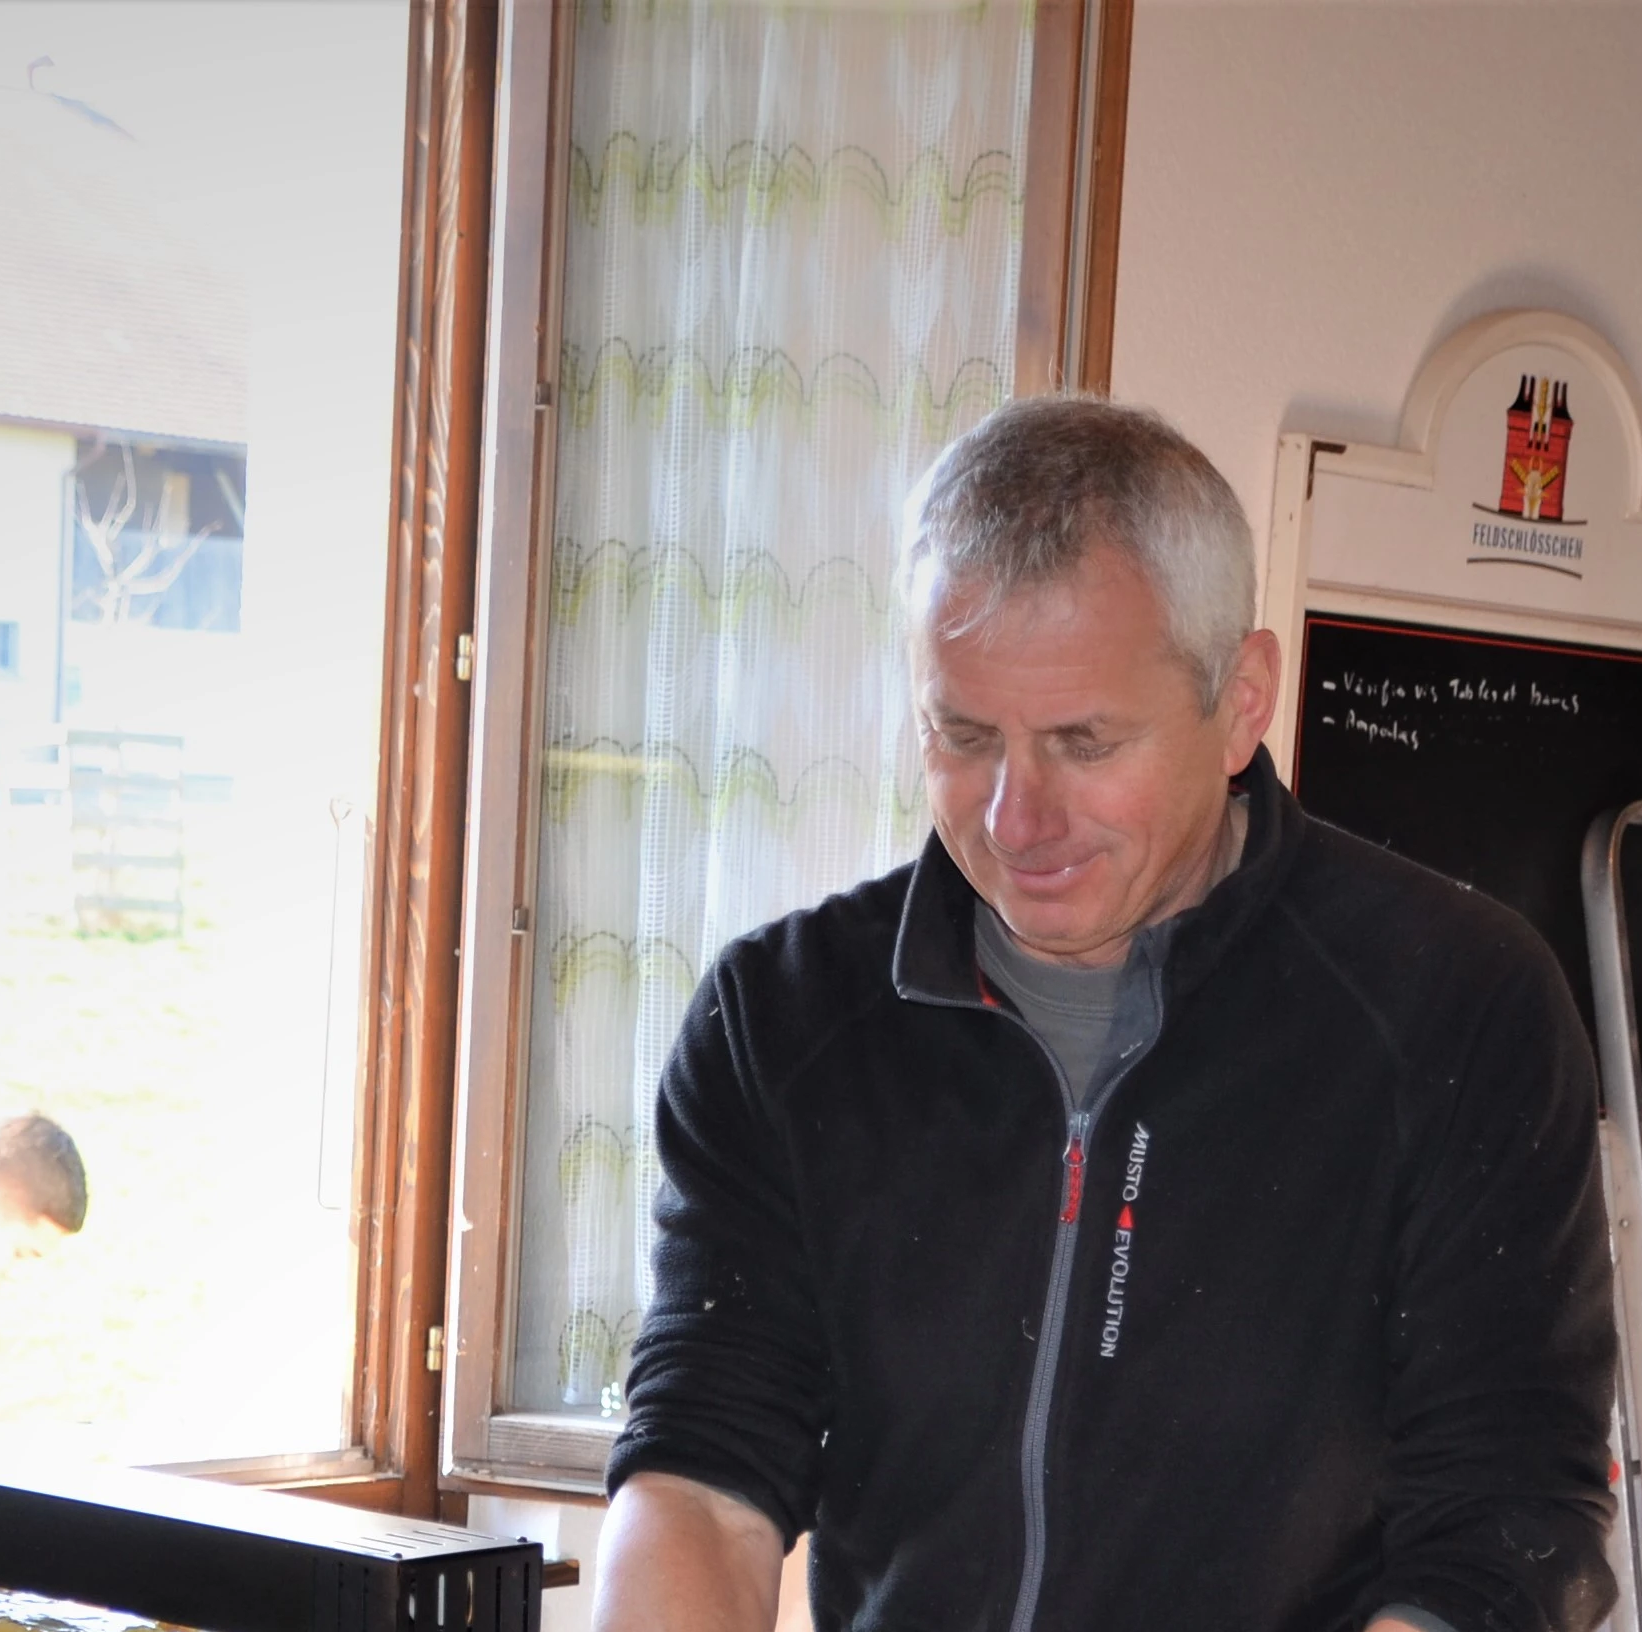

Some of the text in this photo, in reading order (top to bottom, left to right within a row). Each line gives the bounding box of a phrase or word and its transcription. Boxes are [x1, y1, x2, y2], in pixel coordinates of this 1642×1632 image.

[1472, 522, 1583, 560] FELDSCHLÖSSCHEN
[1100, 1120, 1150, 1359] MUSTO EVOLUTION
